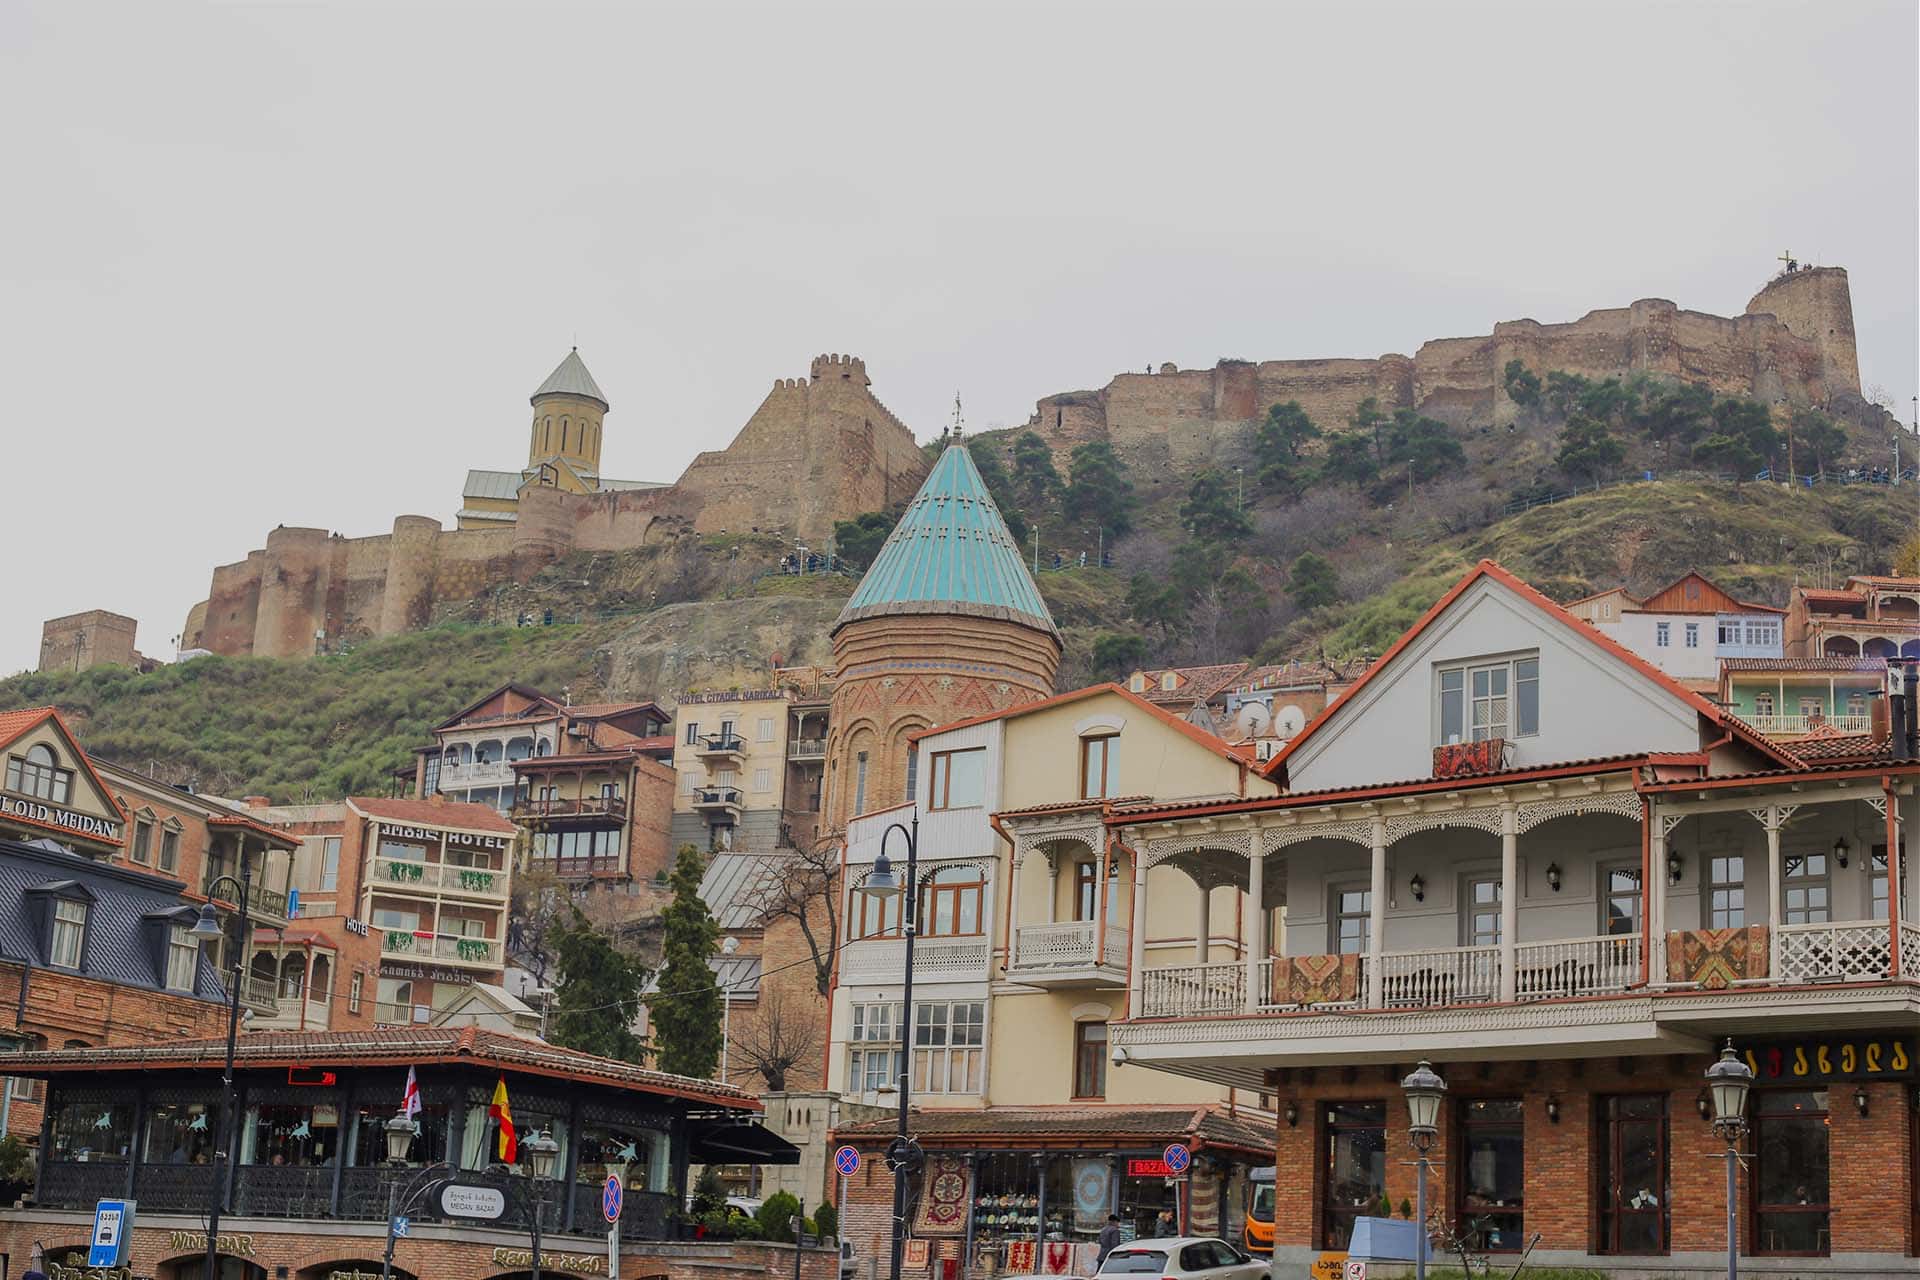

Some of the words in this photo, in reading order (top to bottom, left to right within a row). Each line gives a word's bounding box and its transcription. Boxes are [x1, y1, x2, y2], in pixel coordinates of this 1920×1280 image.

[678, 694, 705, 705] HOTEL
[706, 691, 739, 704] CITADEL
[742, 689, 785, 701] NARIKALA
[15, 800, 48, 821] OLD
[55, 809, 115, 838] MEIDAN
[448, 832, 505, 849] HOTEL
[346, 916, 369, 937] HOTEL
[215, 1235, 256, 1256] BAR
